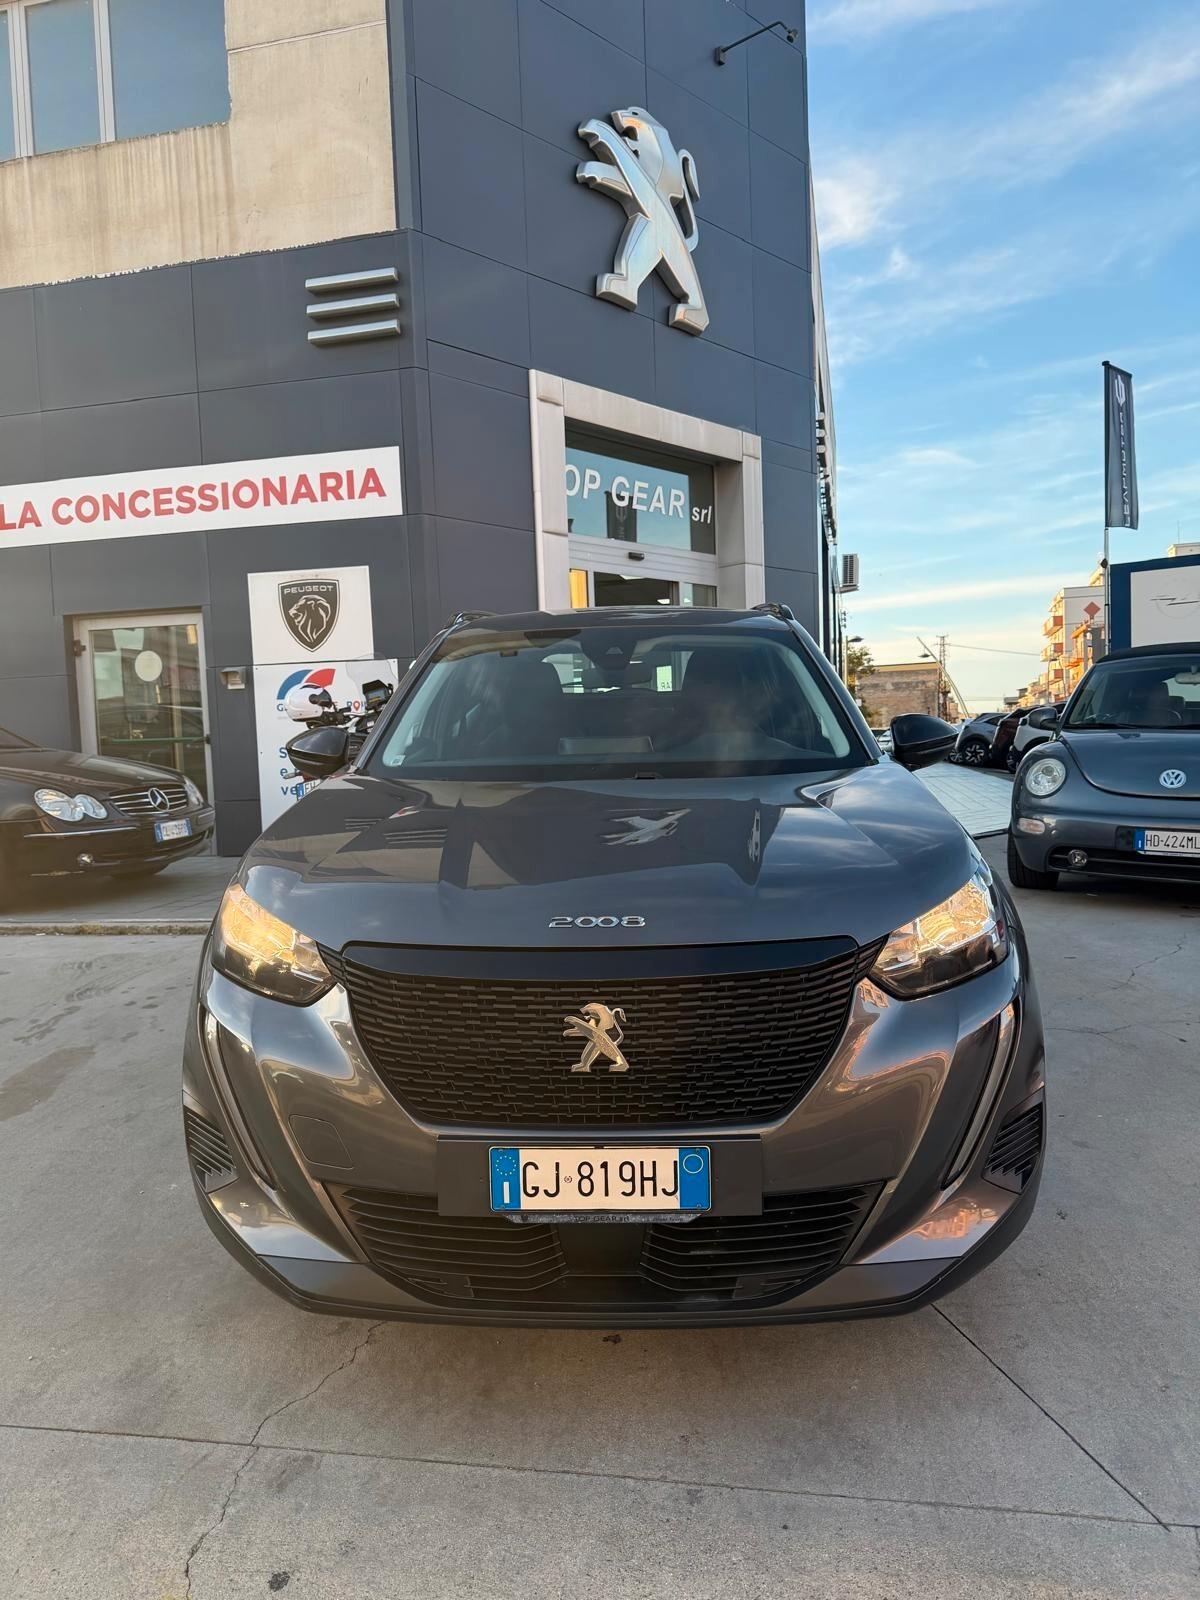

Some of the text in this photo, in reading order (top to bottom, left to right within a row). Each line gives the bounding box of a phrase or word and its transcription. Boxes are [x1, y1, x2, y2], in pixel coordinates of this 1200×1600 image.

[51, 467, 387, 525] CONCESSIONARIA
[565, 463, 713, 524] OP GEAR srl
[283, 585, 334, 594] PEUGEOT
[549, 915, 646, 928] 2008
